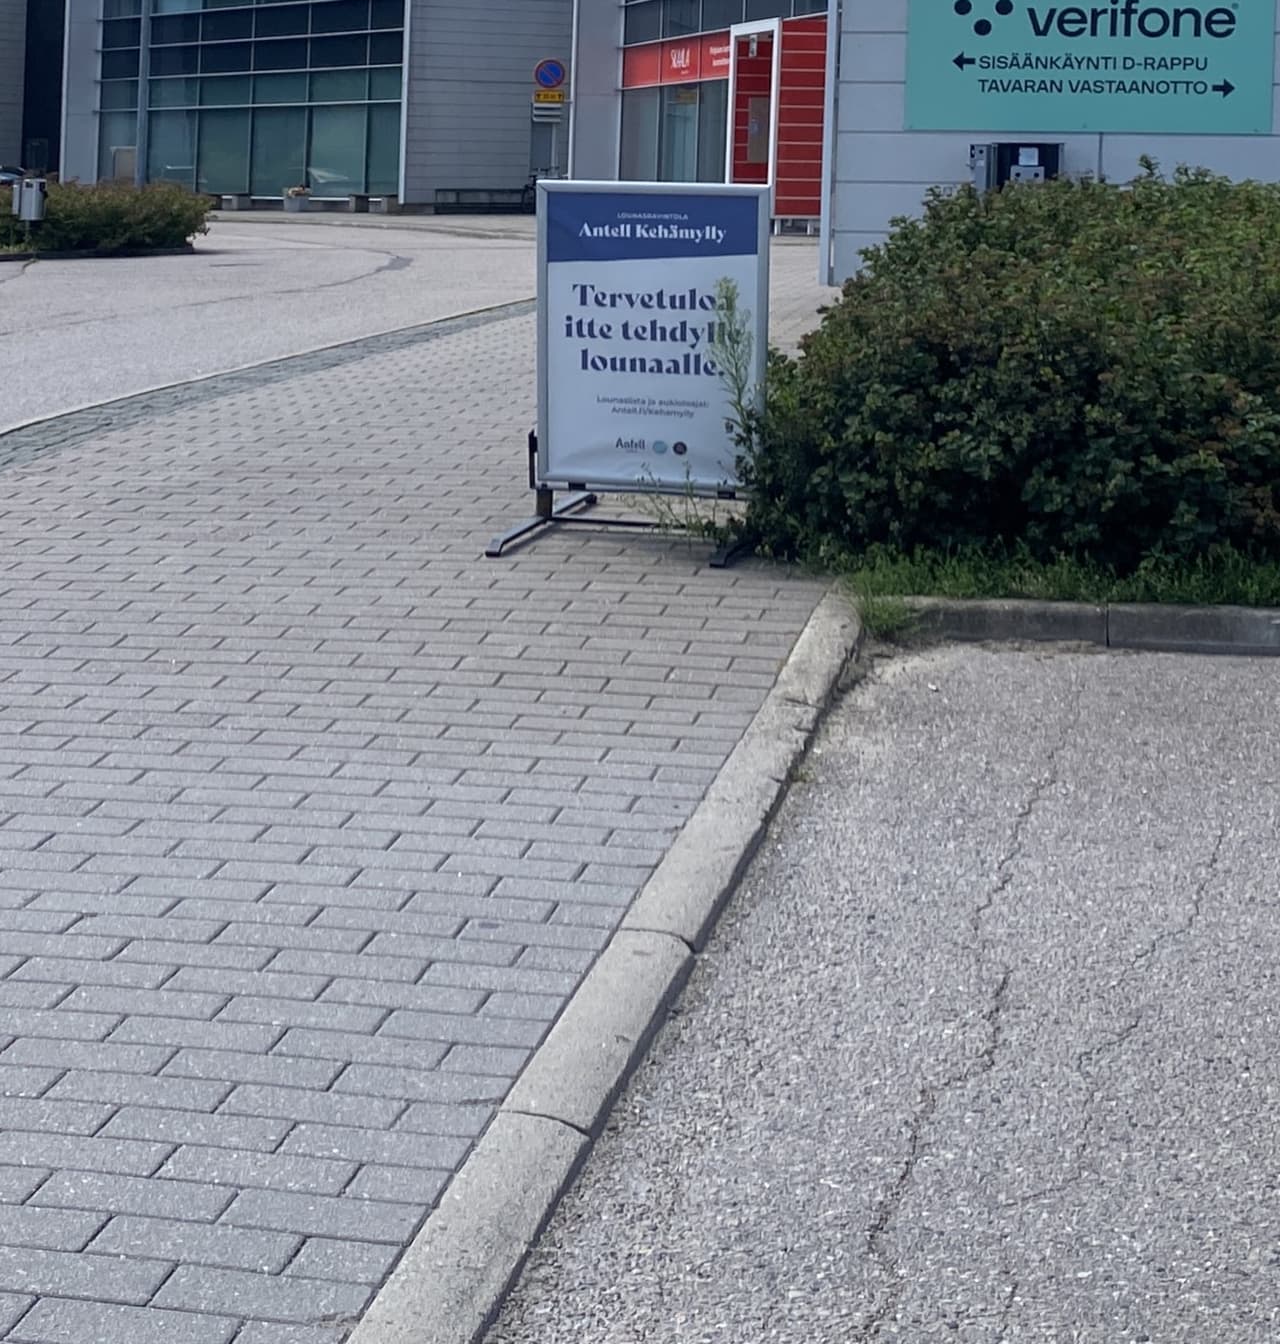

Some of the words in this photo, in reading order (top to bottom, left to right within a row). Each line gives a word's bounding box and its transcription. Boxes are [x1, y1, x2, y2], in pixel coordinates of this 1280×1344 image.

[978, 52, 1118, 71] SISÄÄNKÄYNTI
[1122, 56, 1209, 71] D-RAPPU
[977, 78, 1064, 94] TAVARAN
[1068, 79, 1209, 95] VASTAANOTTO
[578, 221, 632, 239] Antell
[635, 223, 727, 244] Kehämylly
[565, 315, 613, 340] itte
[580, 348, 725, 378] lounaalle.
